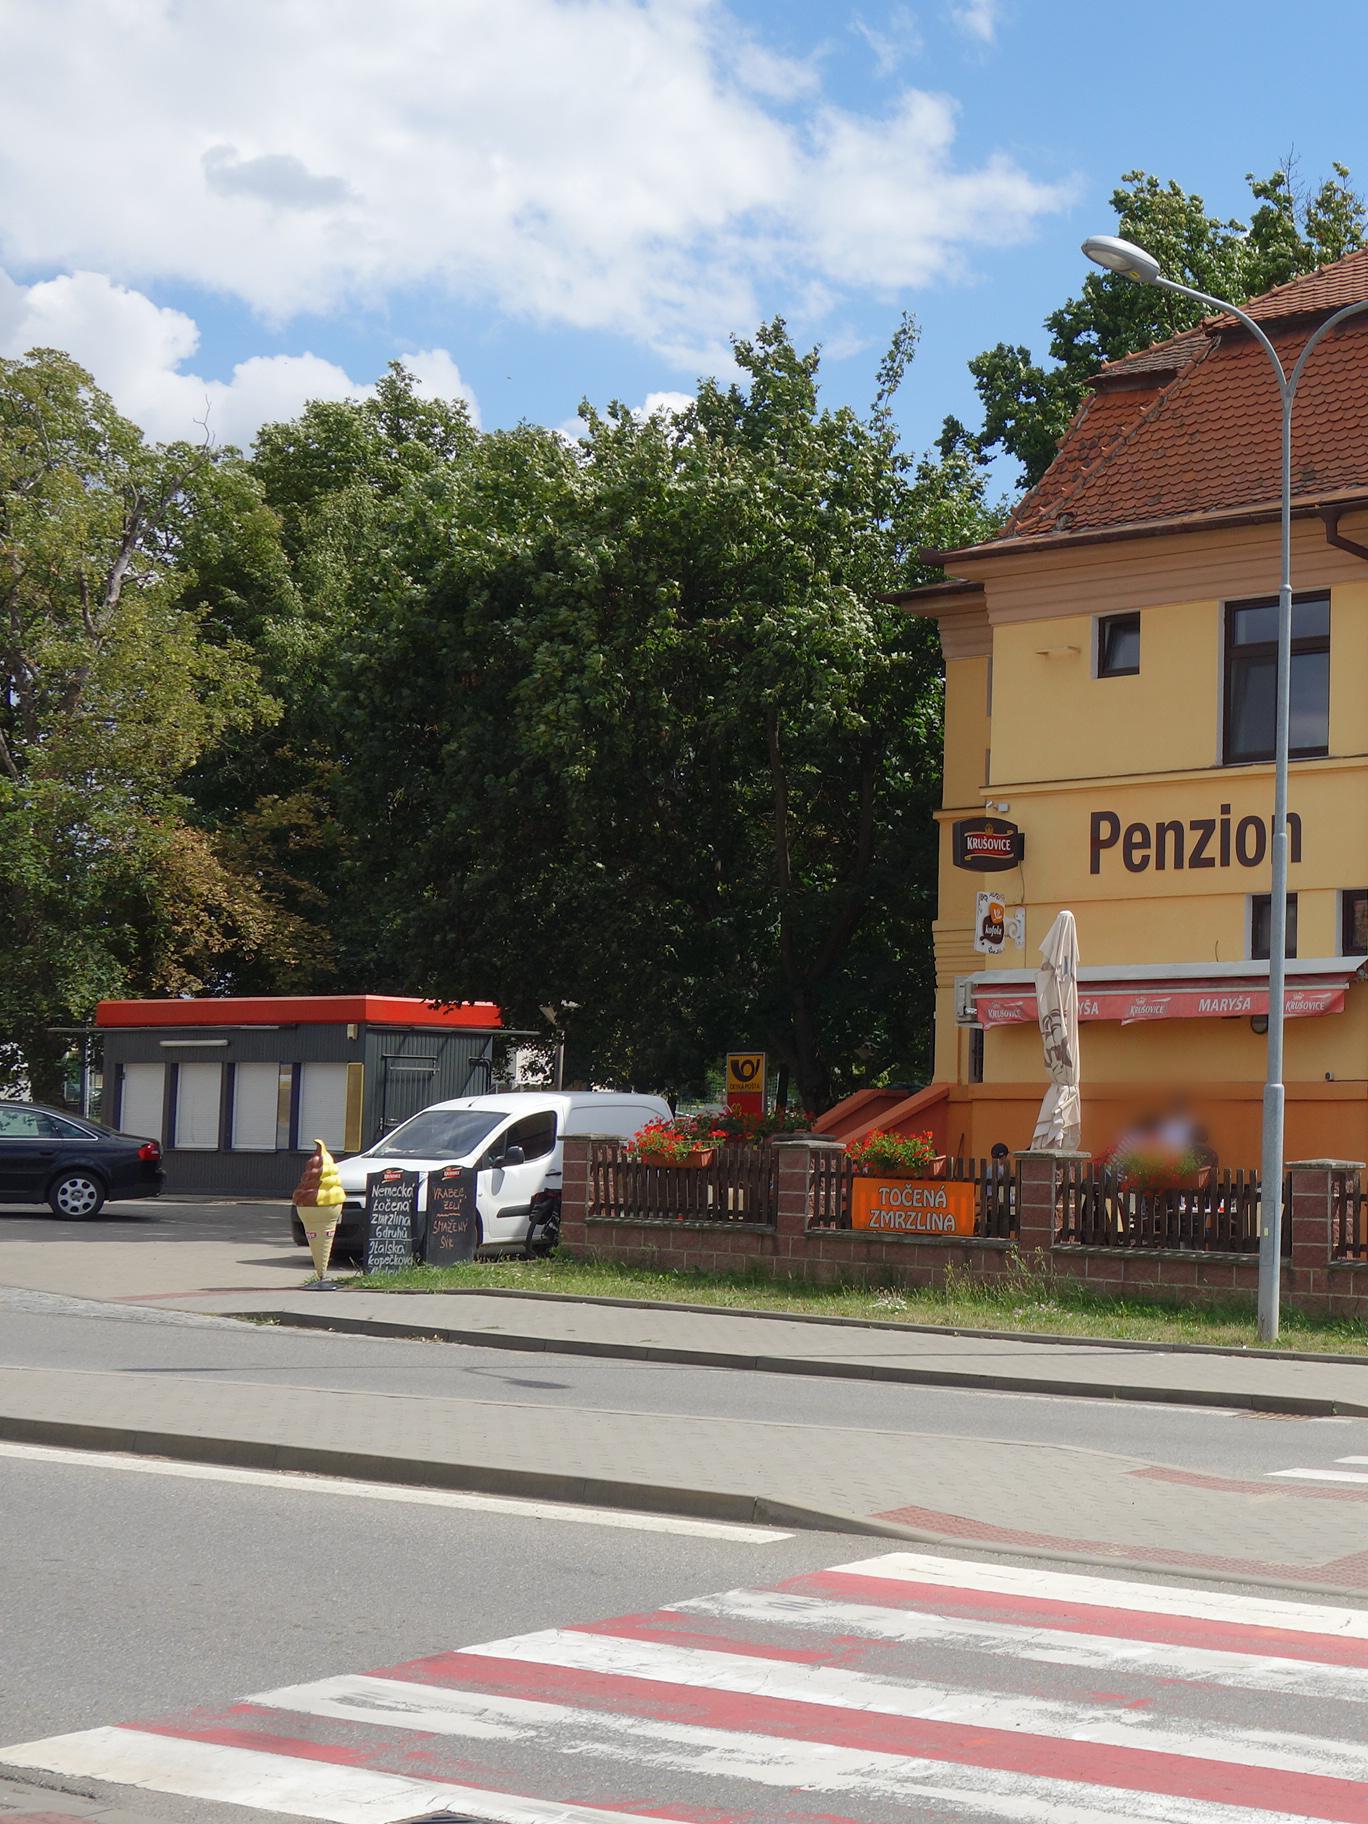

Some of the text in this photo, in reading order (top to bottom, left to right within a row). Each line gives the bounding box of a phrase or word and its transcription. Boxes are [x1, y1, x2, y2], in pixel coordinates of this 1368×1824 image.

[966, 836, 1011, 851] KRUŠOVICE
[1090, 803, 1302, 875] Penzion
[1078, 999, 1100, 1015] YŠA
[1198, 996, 1251, 1013] MARYŠA
[879, 1183, 948, 1209] TOČENÁ
[869, 1209, 956, 1232] ZMRZLINA
